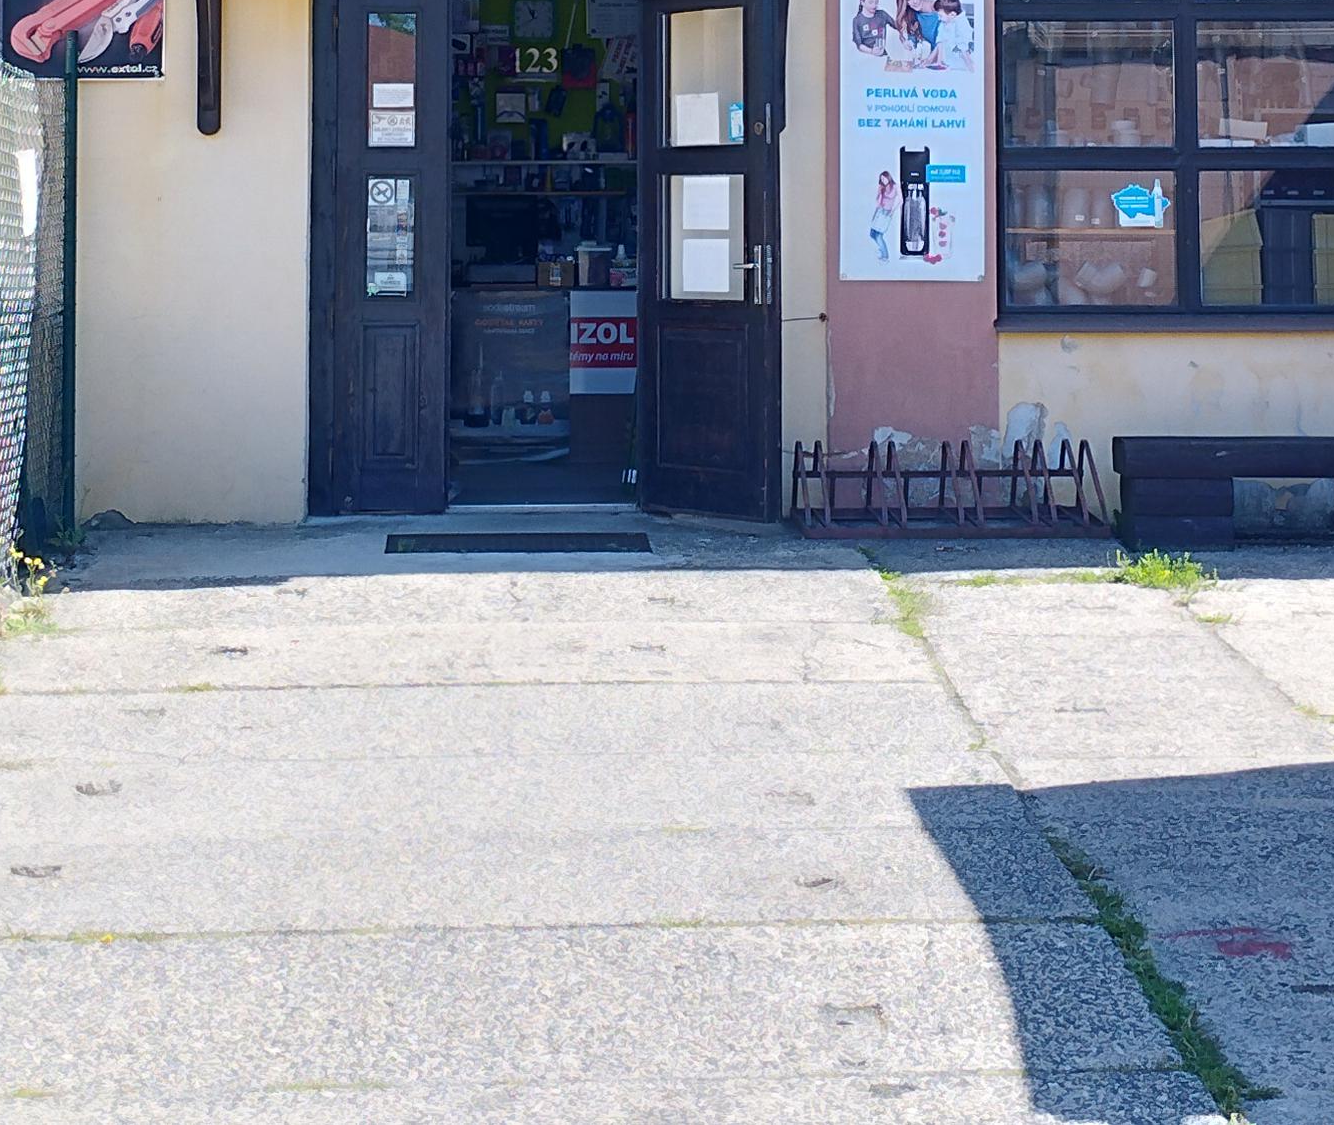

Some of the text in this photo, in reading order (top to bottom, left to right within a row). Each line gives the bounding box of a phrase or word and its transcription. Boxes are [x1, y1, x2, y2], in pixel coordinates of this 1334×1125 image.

[866, 86, 958, 98] PERLIVÁ VODA
[857, 116, 966, 128] BEZ TAHÁNÍ LAHVÍ
[571, 322, 635, 344] IZOL
[571, 350, 594, 363] témy
